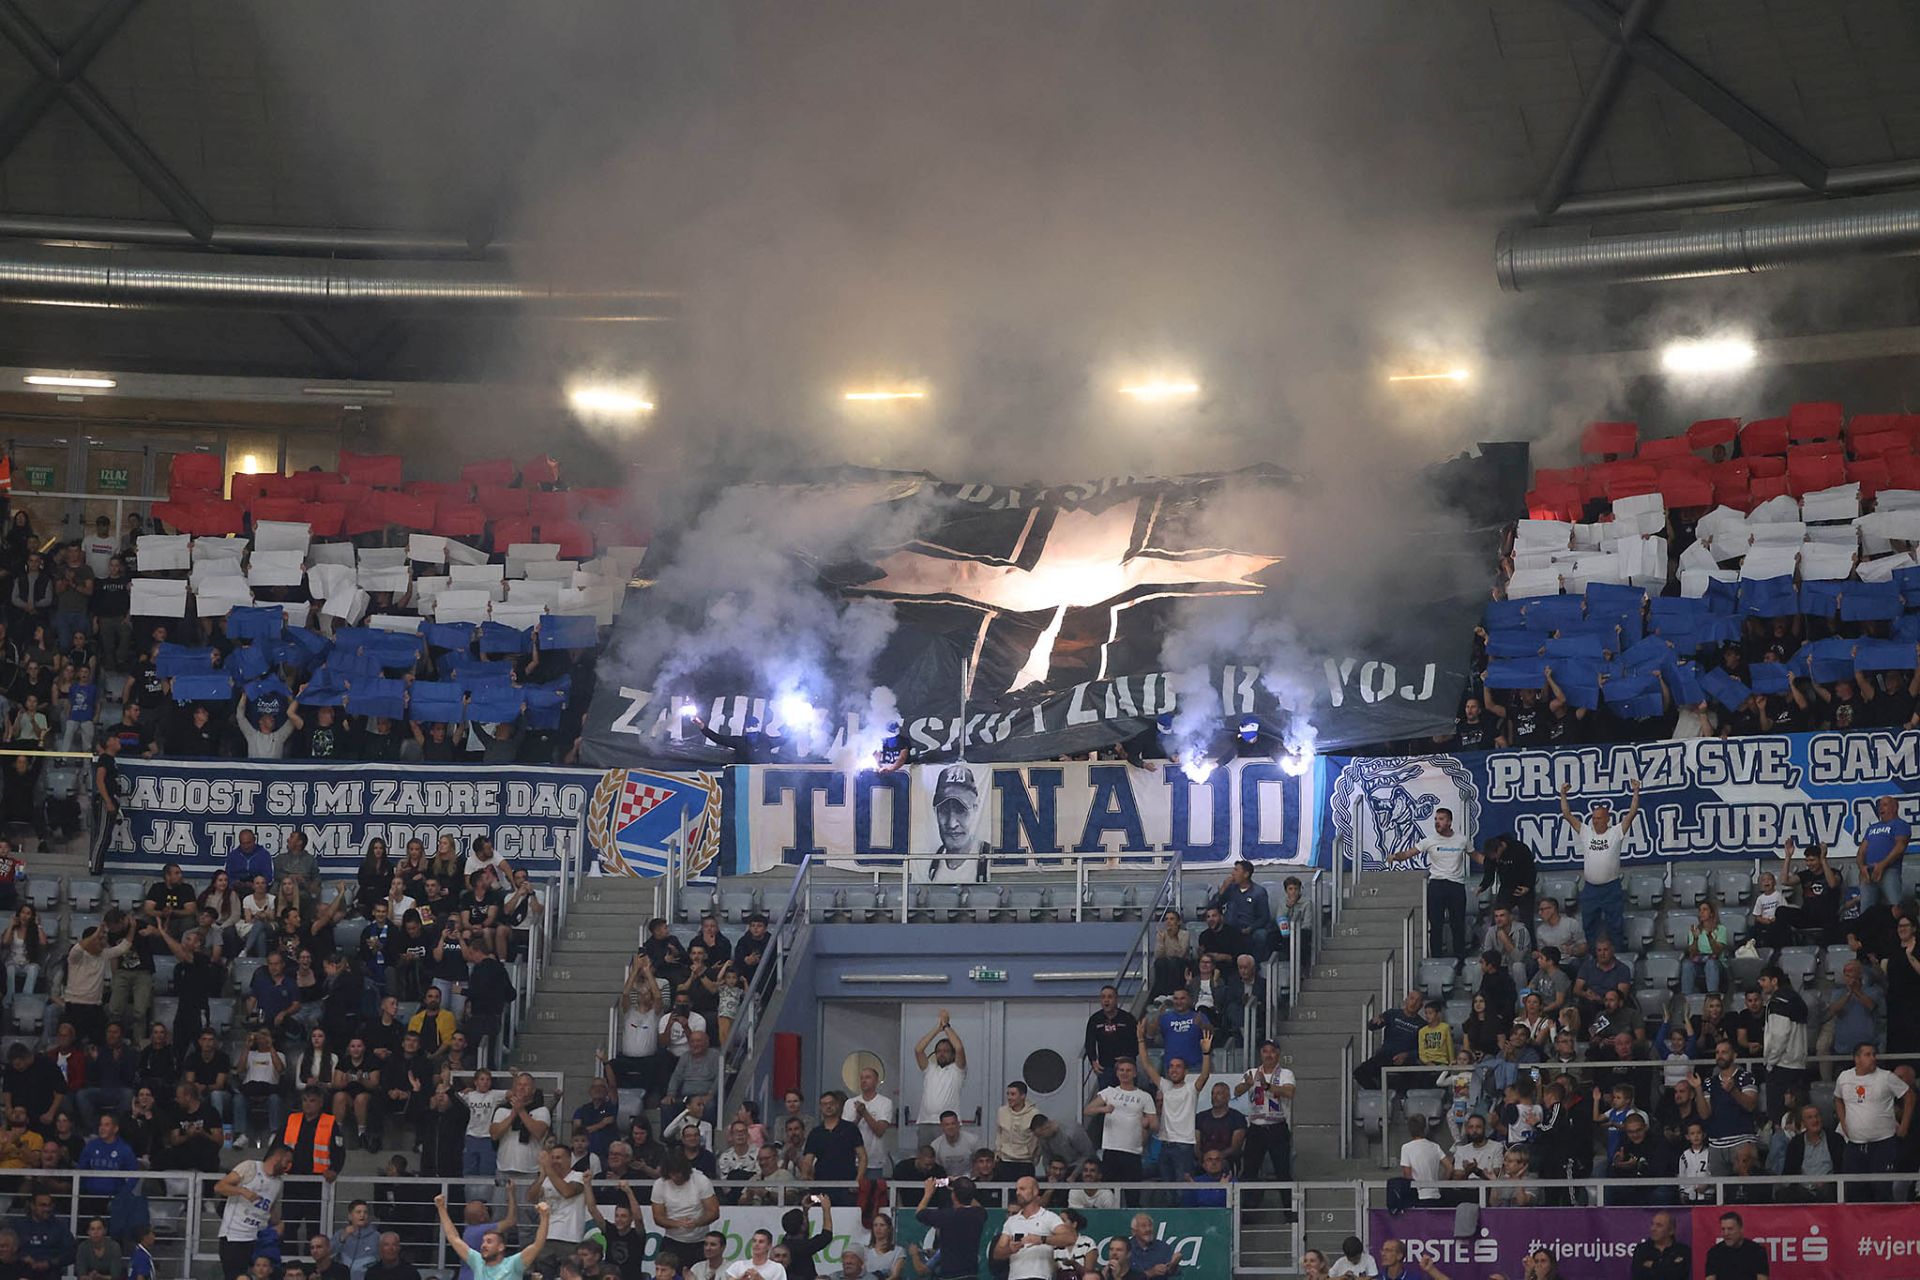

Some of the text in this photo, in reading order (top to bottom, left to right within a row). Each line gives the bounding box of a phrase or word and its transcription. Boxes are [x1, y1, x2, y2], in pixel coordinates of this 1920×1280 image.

[101, 469, 128, 480] IZLAZ
[1488, 742, 1687, 800] PROLAZI
[1698, 739, 1801, 789] SVE,
[266, 782, 308, 816] SI
[313, 781, 364, 816] MI
[370, 780, 500, 816] ZADRE
[506, 781, 587, 818] DAO
[762, 762, 1305, 867] TONADO
[142, 819, 198, 855] JA
[1517, 802, 1651, 861] NAA
[1658, 801, 1846, 855] LJUBAV
[254, 1196, 271, 1212] 26
[1528, 1237, 1646, 1261] #vjerujuse
